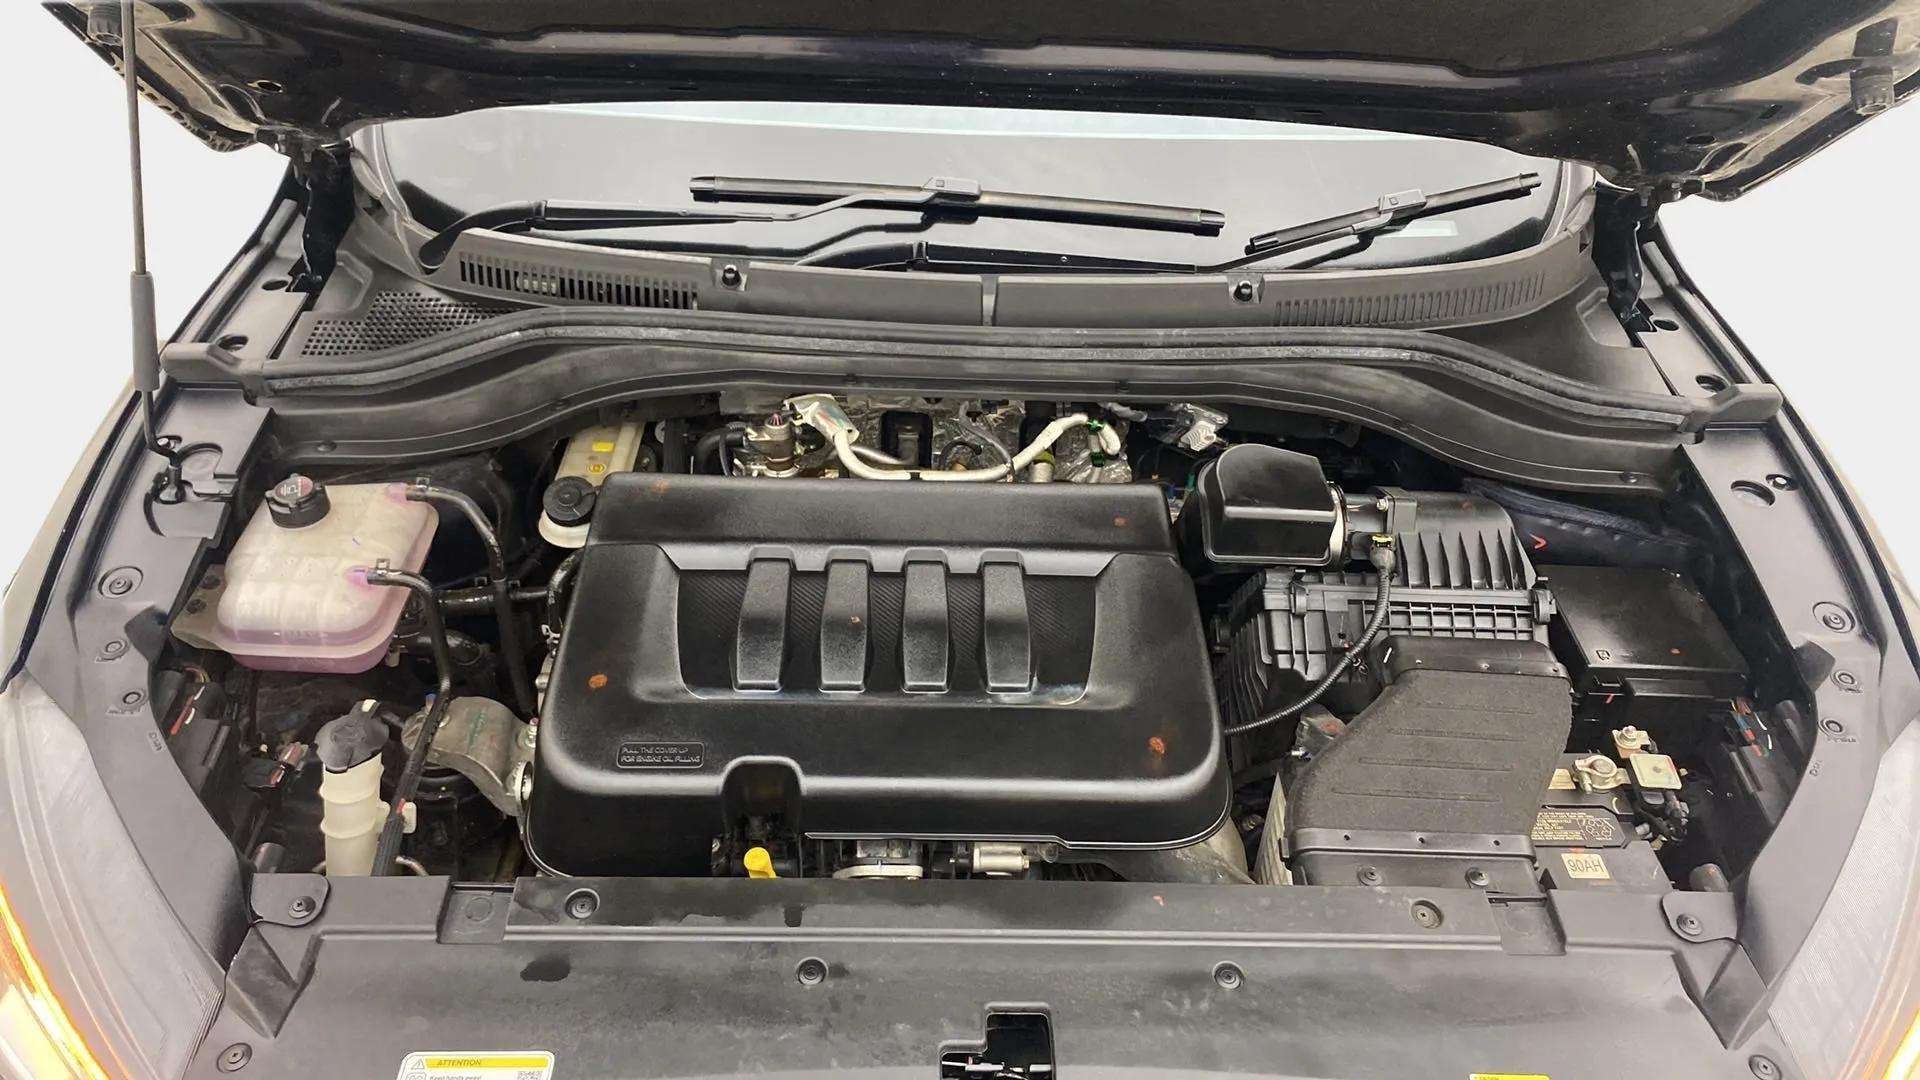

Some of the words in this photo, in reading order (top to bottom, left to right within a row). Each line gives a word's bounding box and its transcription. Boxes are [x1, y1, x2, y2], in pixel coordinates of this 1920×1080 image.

[621, 755, 635, 763] FOR
[636, 755, 662, 763] ENGINE
[1567, 858, 1605, 873] 90AH
[437, 1059, 482, 1067] ATTENTION
